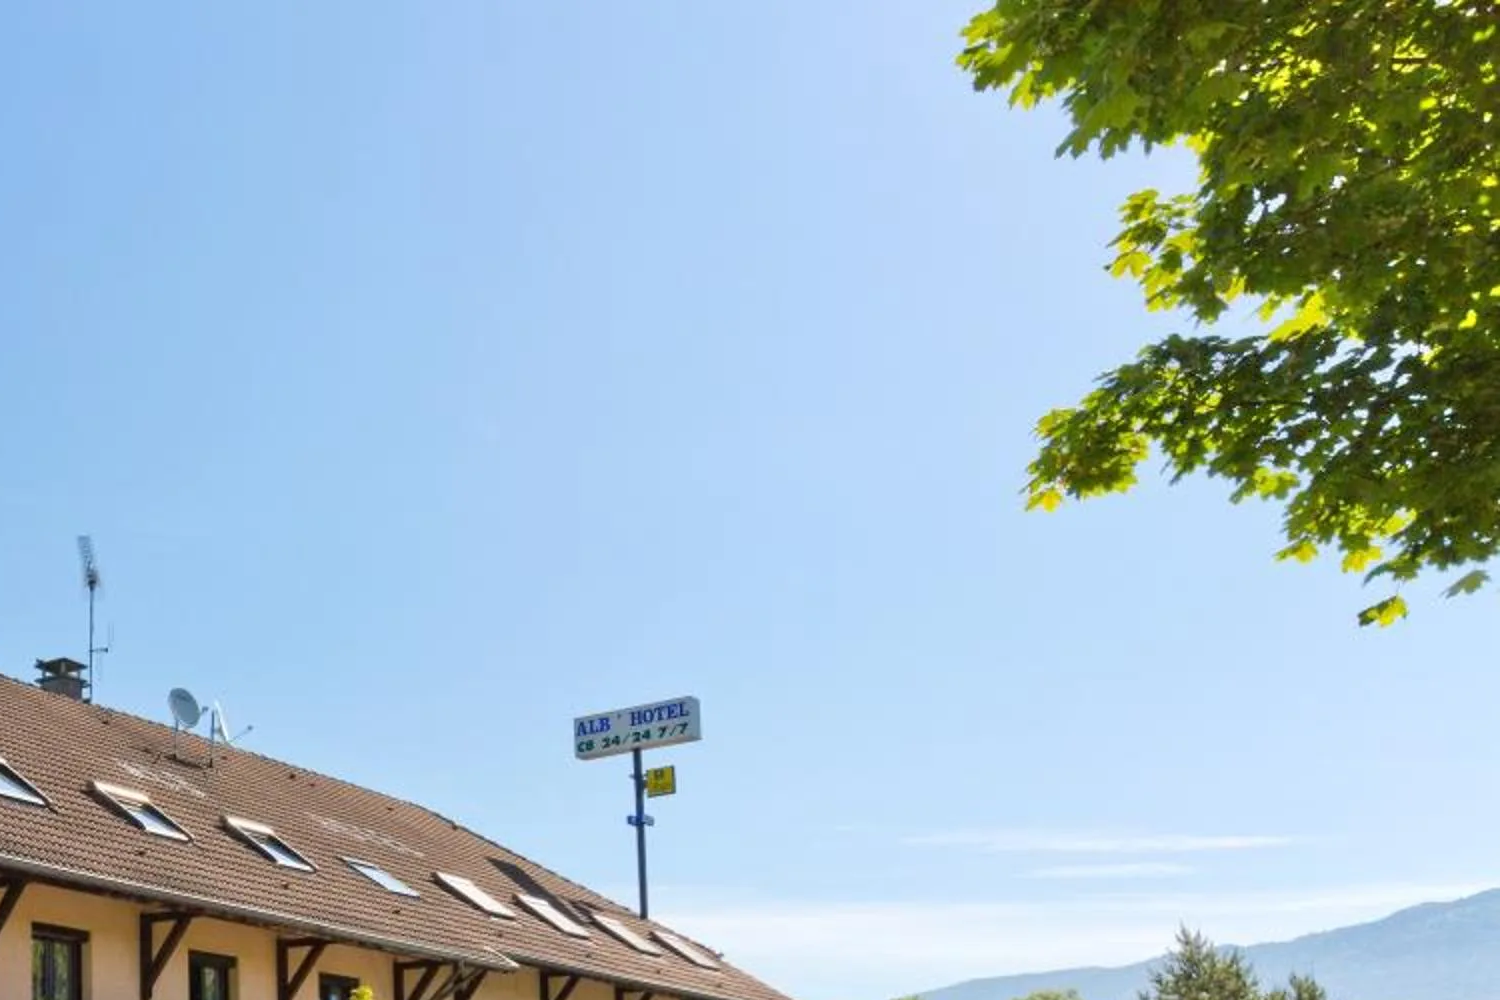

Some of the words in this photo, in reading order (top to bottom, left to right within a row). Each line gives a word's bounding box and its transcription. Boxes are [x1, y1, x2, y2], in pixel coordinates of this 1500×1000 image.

[629, 702, 690, 727] HOTEL
[577, 740, 596, 753] CB
[602, 729, 652, 749] 24/24
[658, 721, 689, 739] 7/7
